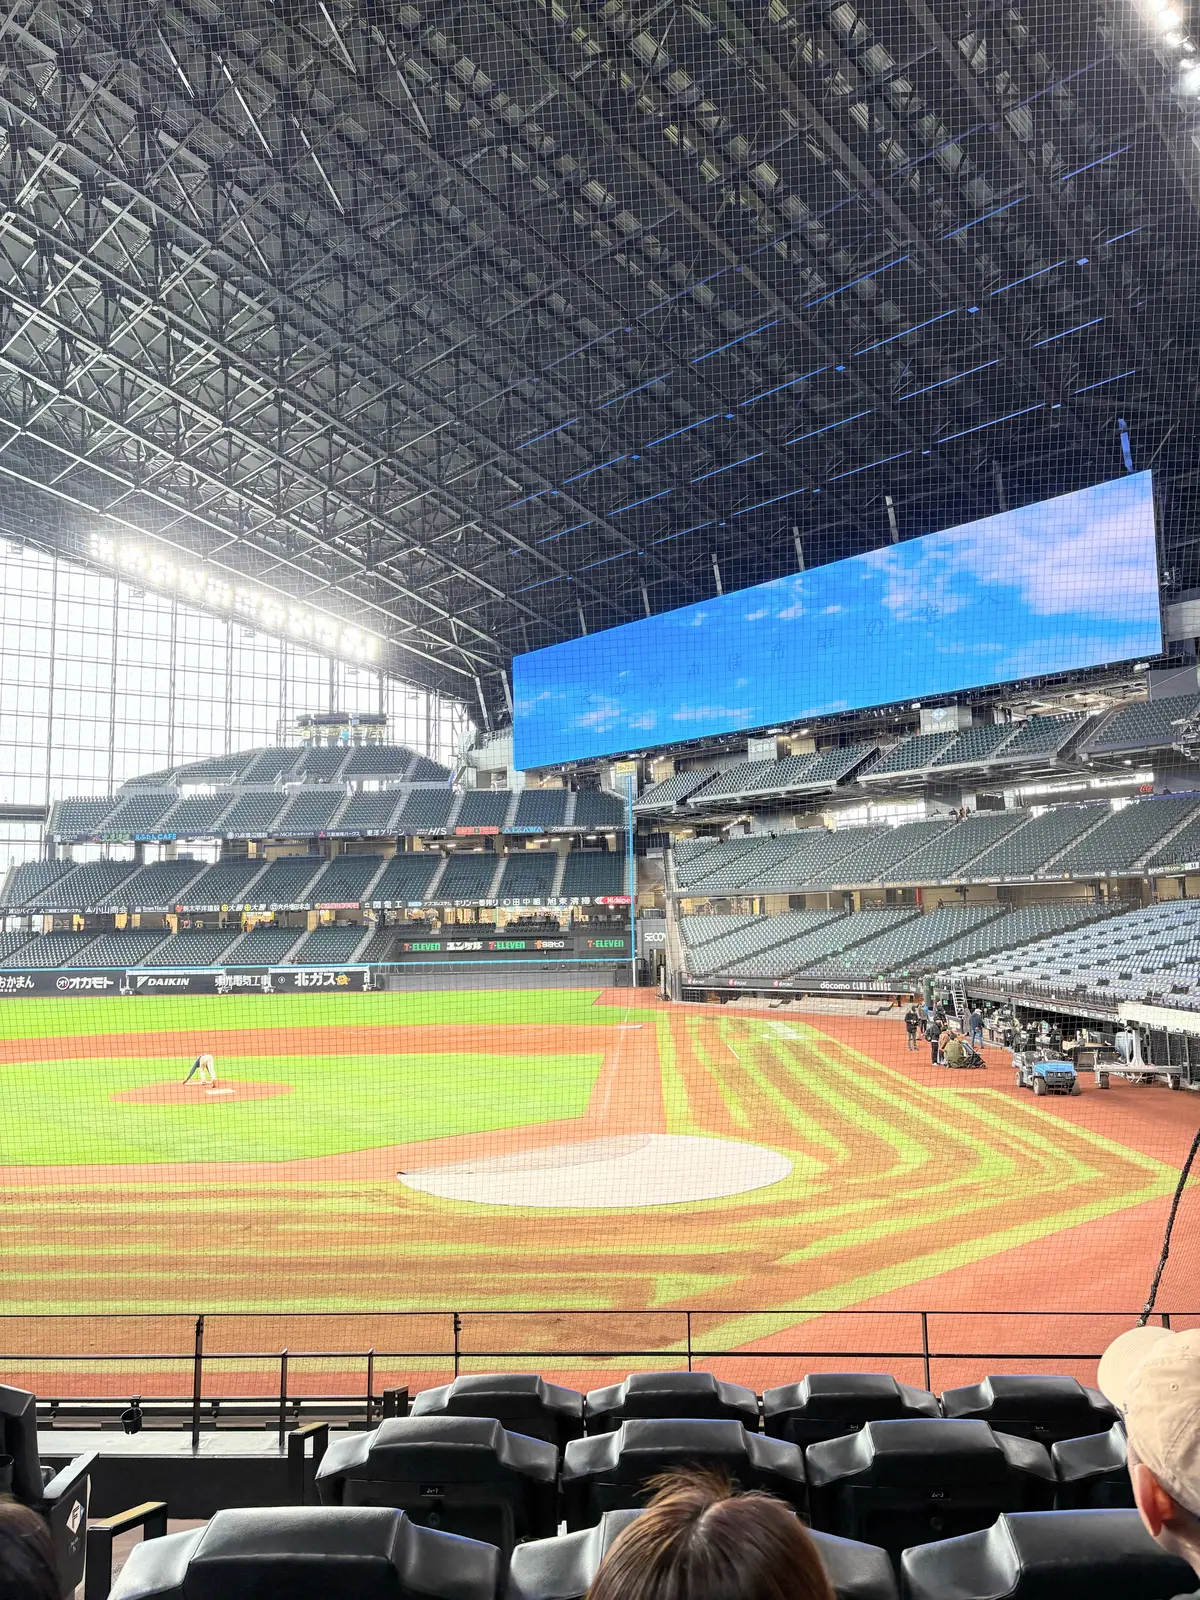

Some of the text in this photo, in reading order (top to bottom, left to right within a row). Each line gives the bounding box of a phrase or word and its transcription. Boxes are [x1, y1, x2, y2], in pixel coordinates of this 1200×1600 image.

[512, 898, 541, 906] 田中組
[92, 906, 128, 915] 小山商会
[69, 977, 114, 989] オカモト
[147, 978, 190, 986] DAIKIN
[294, 972, 337, 987] 北ガス
